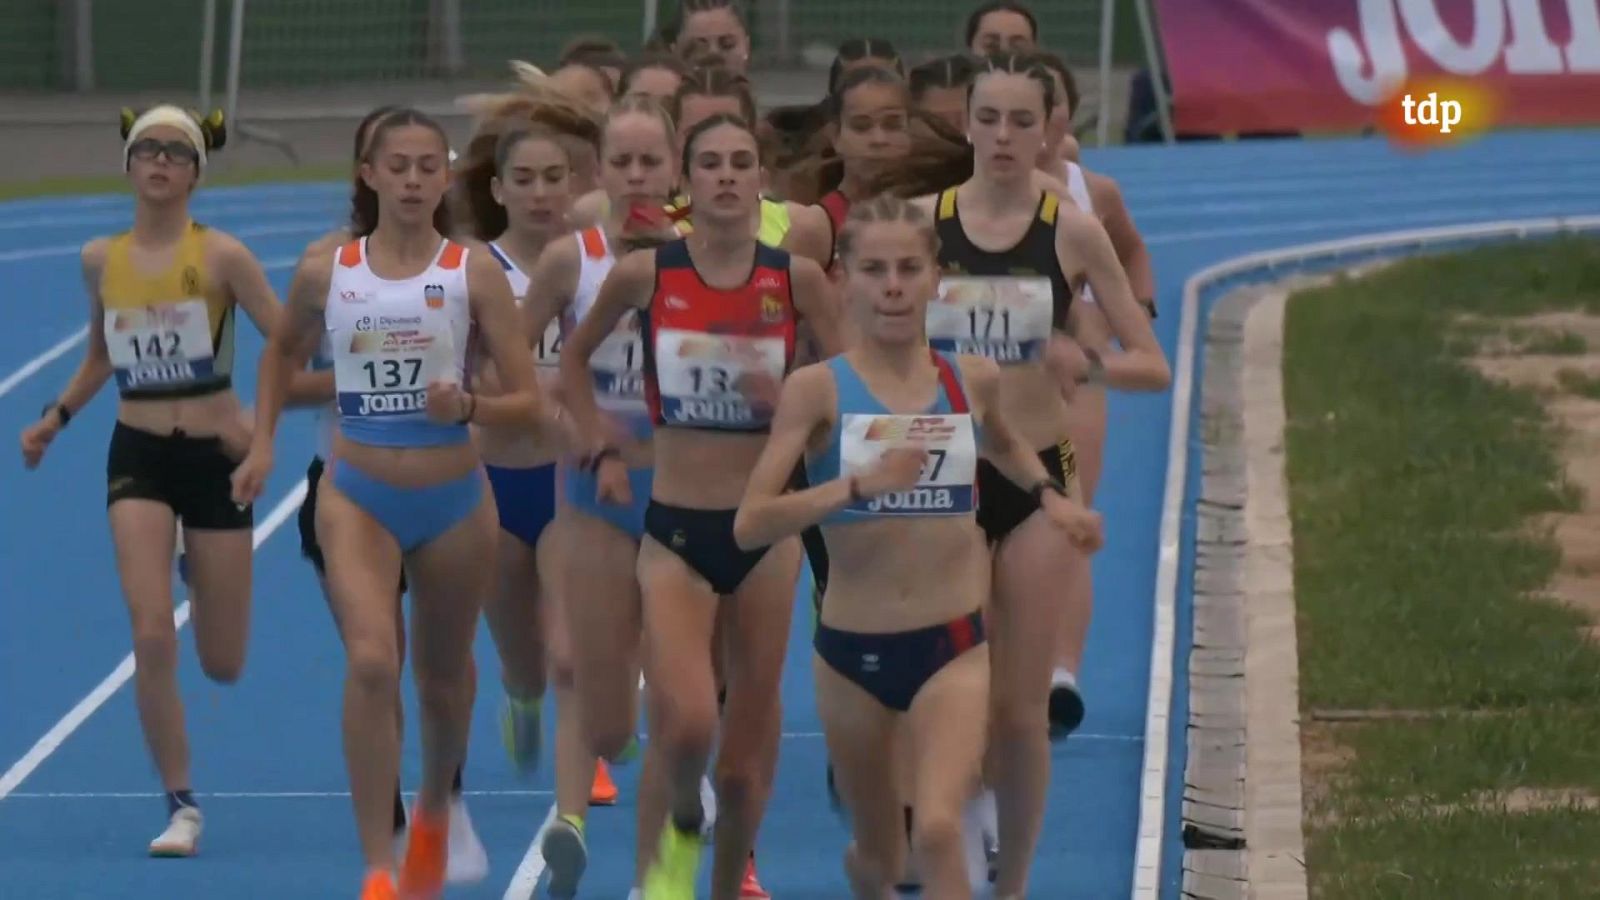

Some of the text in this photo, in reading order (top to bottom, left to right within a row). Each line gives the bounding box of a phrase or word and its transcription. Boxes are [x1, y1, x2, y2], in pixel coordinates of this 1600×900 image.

[967, 306, 1010, 340] 171
[129, 331, 183, 361] 142
[363, 358, 422, 388] 137
[689, 366, 738, 396] 13
